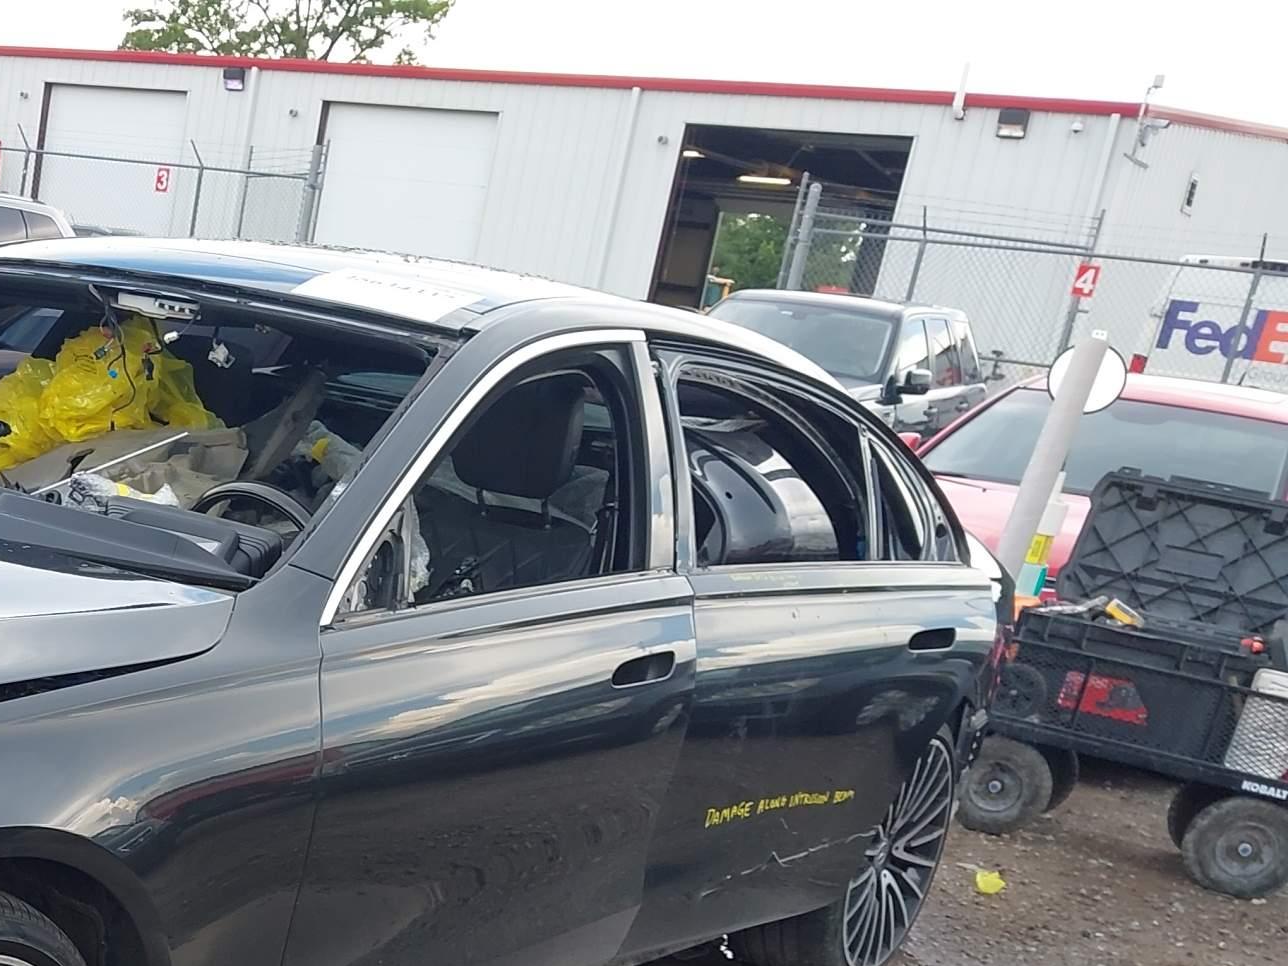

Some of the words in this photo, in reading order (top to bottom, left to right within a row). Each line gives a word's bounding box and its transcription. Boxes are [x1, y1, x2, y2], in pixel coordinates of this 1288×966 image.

[157, 170, 168, 190] 3
[1074, 268, 1096, 294] 4
[1155, 299, 1288, 364] FedE
[1241, 780, 1288, 800] KOBALT
[704, 801, 755, 829] DAMAGE
